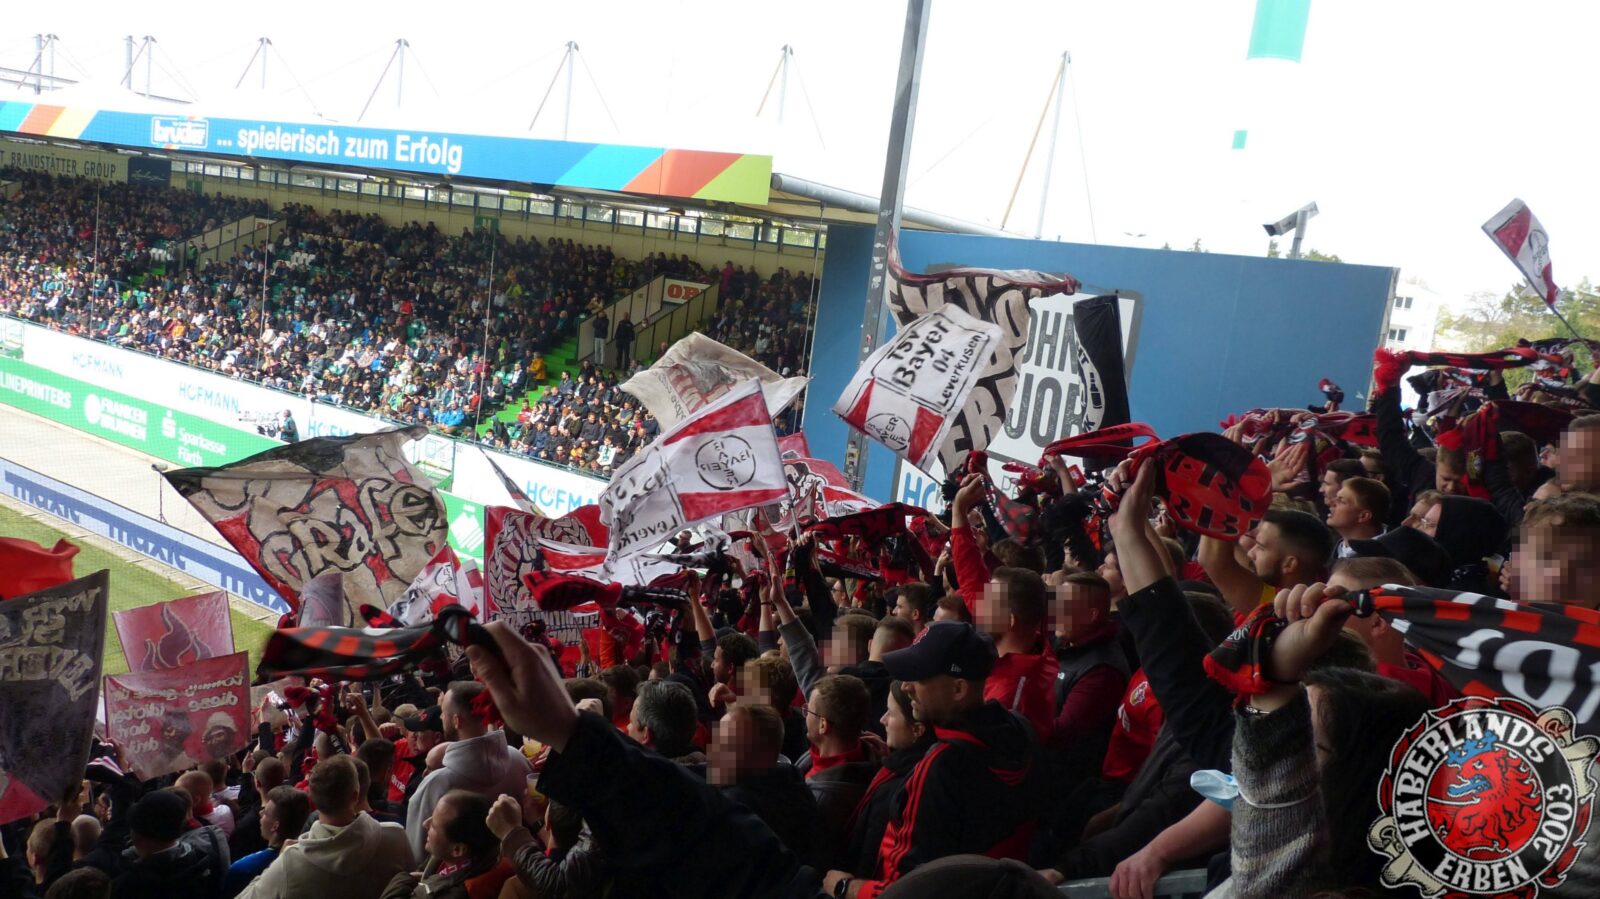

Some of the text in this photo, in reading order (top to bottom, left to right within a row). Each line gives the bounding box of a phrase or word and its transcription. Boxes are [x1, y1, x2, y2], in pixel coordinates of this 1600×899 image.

[237, 125, 339, 158] spielerisch
[345, 136, 388, 160] zum
[395, 133, 463, 173] Erfolg
[84, 161, 116, 179] GROUP
[887, 329, 920, 362] TSV
[891, 319, 950, 389] Bayer
[933, 348, 956, 374] 04
[939, 334, 983, 407] Leverkusen
[179, 382, 240, 413] HOFMANN
